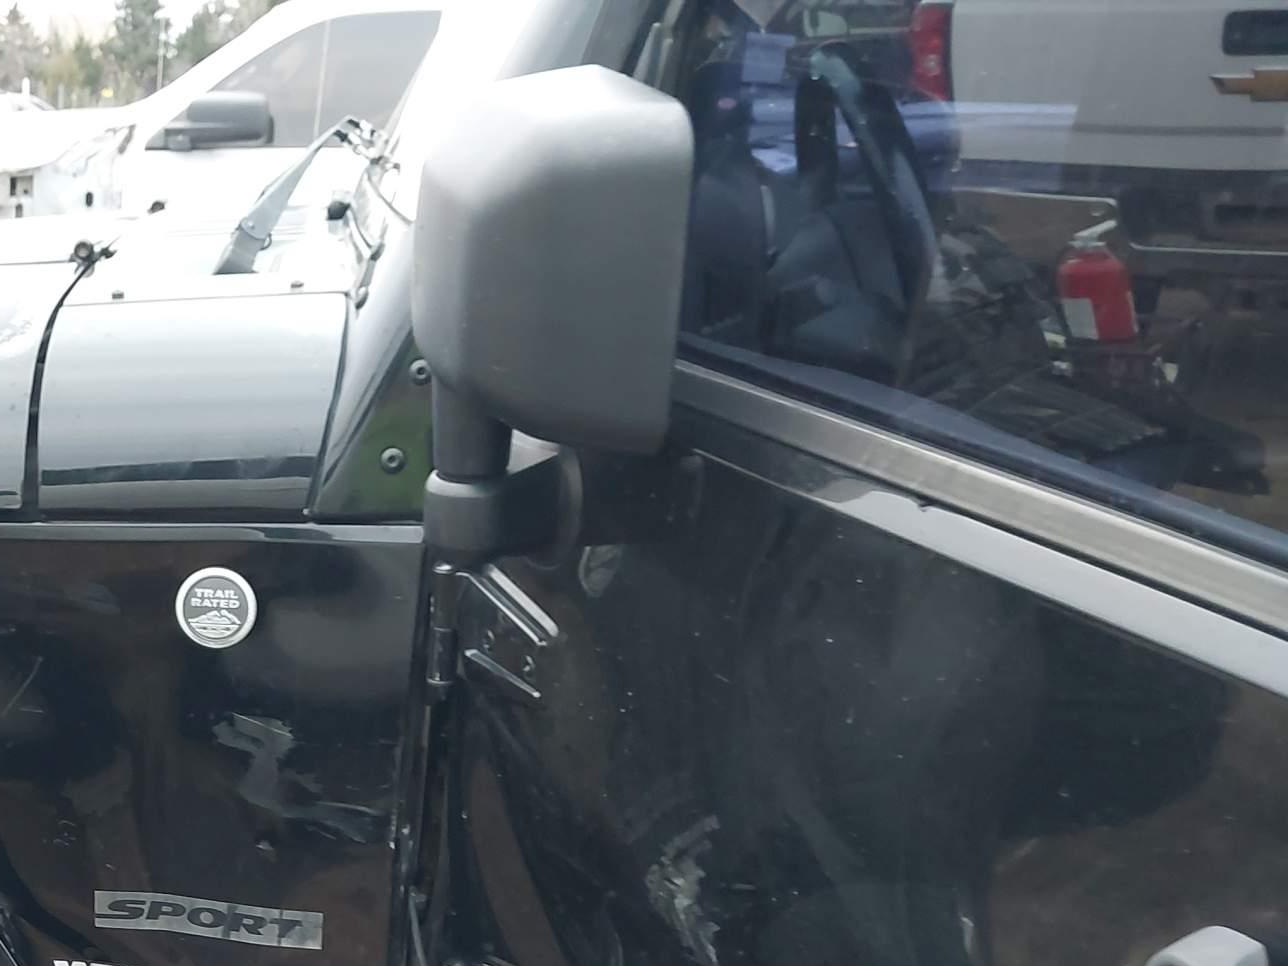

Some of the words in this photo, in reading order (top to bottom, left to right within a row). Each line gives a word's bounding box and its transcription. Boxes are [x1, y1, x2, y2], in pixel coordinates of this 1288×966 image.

[194, 588, 239, 599] TRAIL
[191, 597, 241, 609] RATED
[95, 899, 303, 938] SPORT
